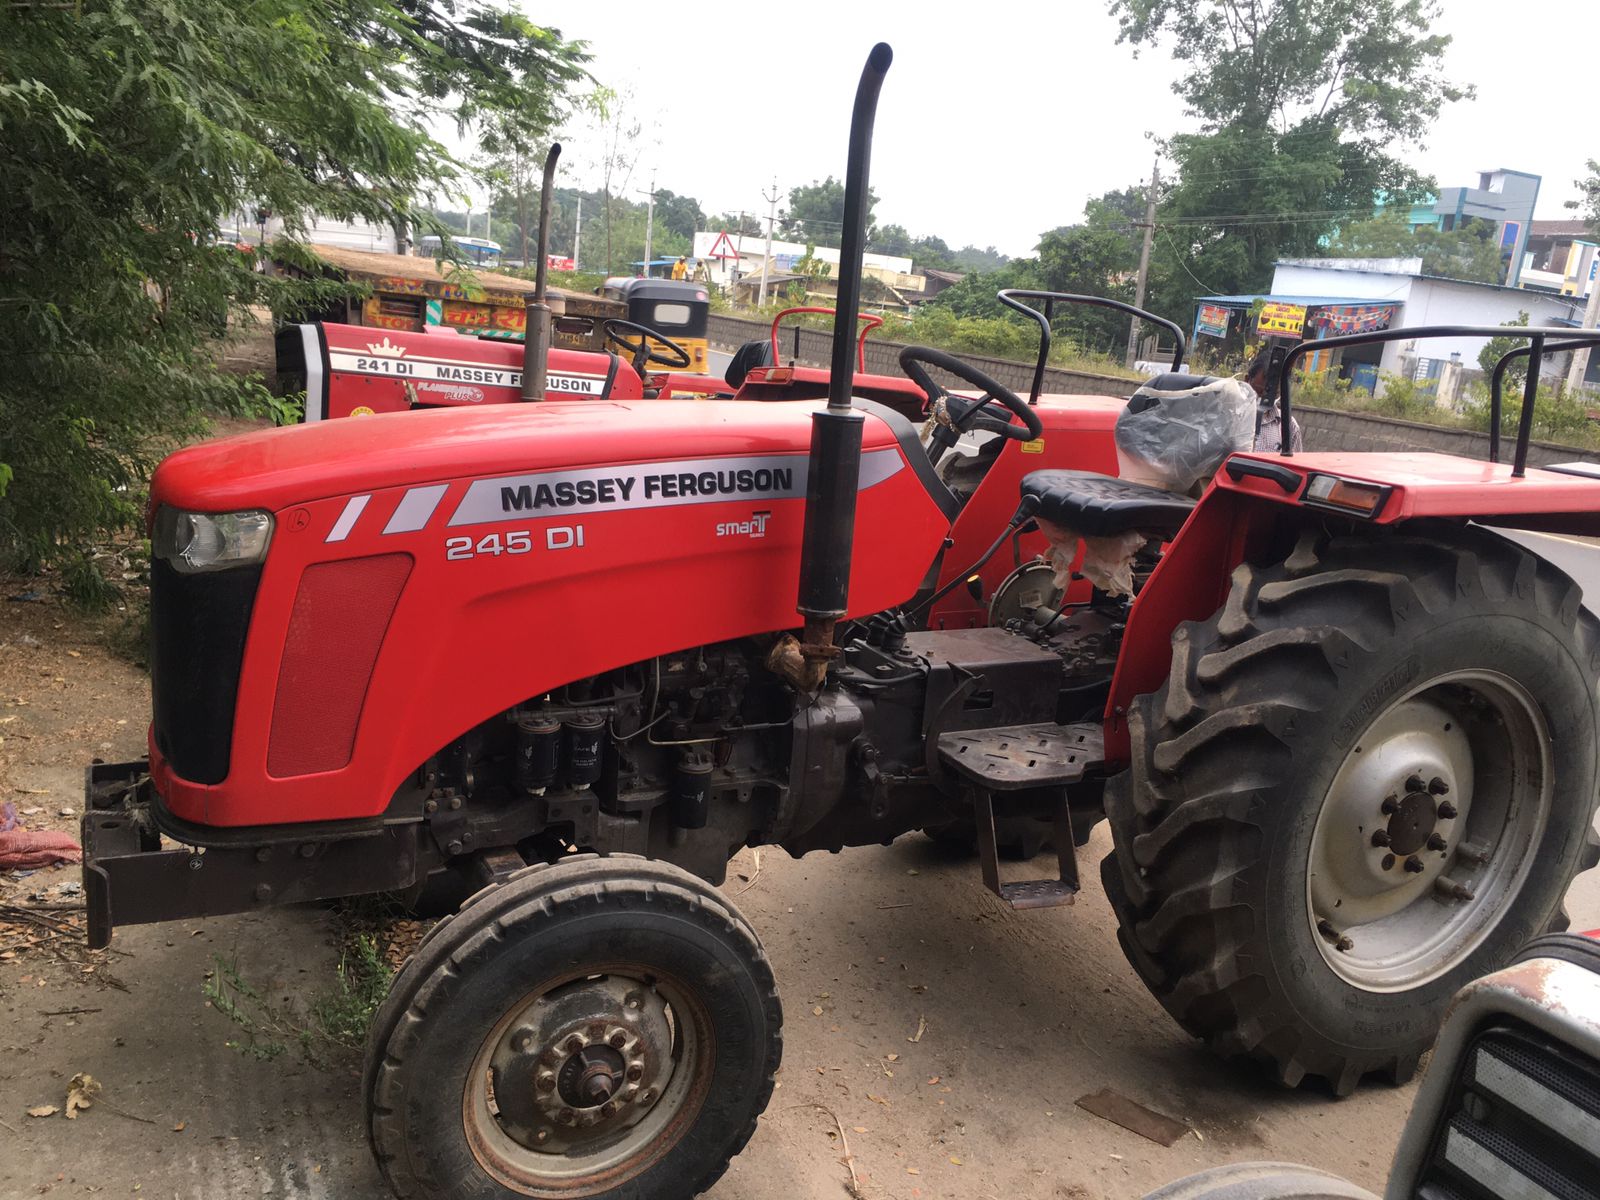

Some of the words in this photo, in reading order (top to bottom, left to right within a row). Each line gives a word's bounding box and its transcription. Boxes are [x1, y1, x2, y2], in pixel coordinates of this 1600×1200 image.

[357, 358, 389, 372] 241
[396, 362, 413, 375] DI
[436, 366, 503, 384] MASSEY
[510, 374, 591, 392] FUSON
[500, 476, 636, 512] MASSEY
[644, 467, 793, 500] FERGUSON
[445, 530, 532, 562] 245
[546, 525, 585, 551] DI
